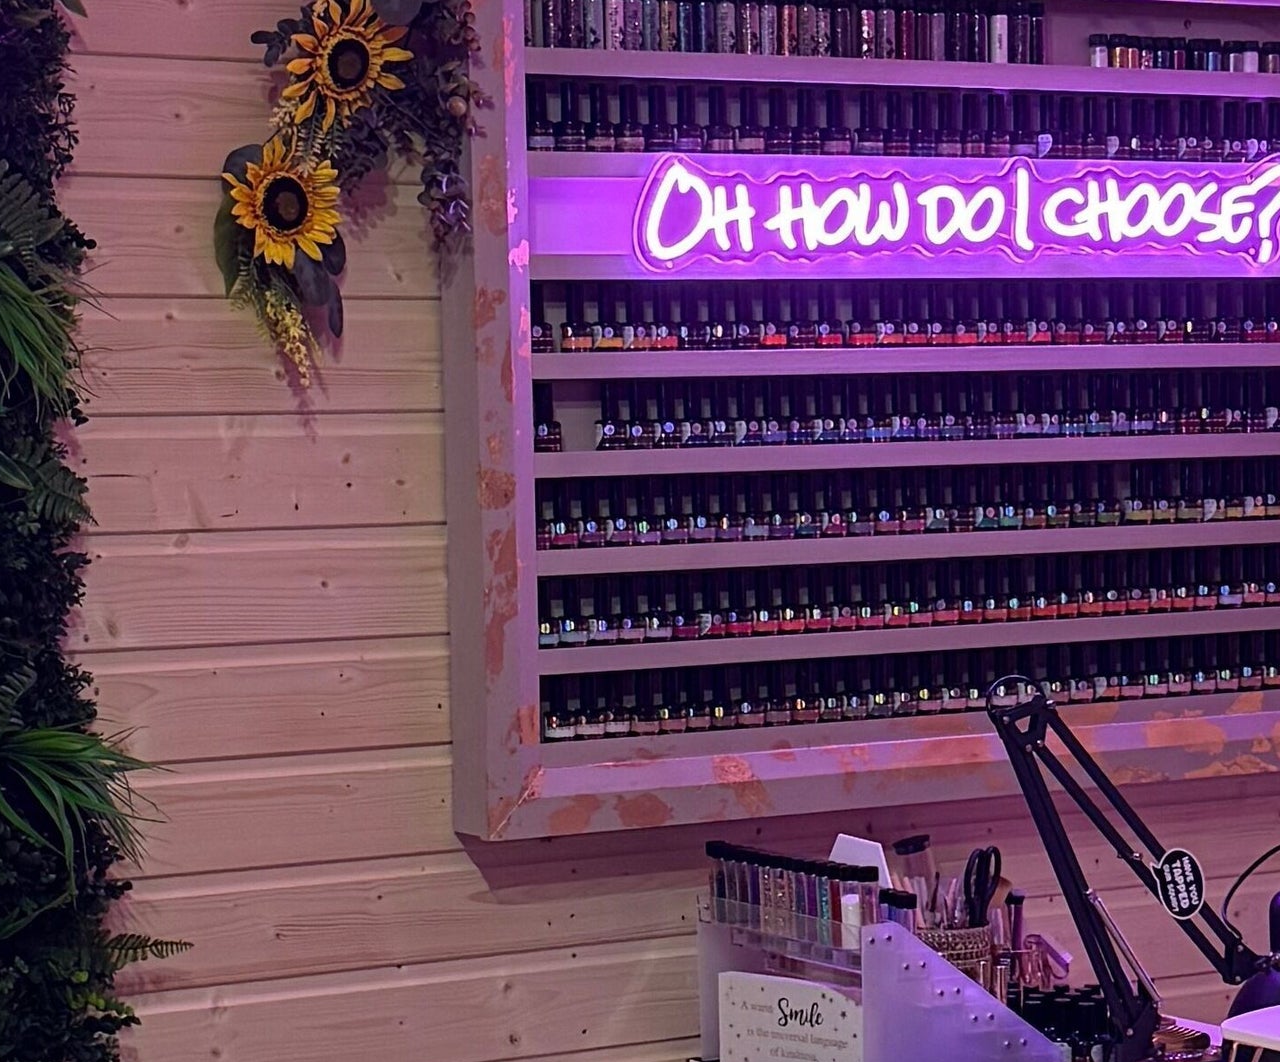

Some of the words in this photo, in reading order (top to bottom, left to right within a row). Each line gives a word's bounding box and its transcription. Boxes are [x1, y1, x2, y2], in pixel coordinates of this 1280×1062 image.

[645, 162, 754, 262] OH
[764, 177, 911, 253] HOW
[917, 183, 1007, 244] DO
[1014, 166, 1034, 251] I
[1171, 859, 1190, 909] TAPPED
[1182, 856, 1195, 883] HAVE
[1189, 883, 1200, 905] YOU
[756, 1027, 769, 1038] the
[777, 997, 824, 1028] Smile
